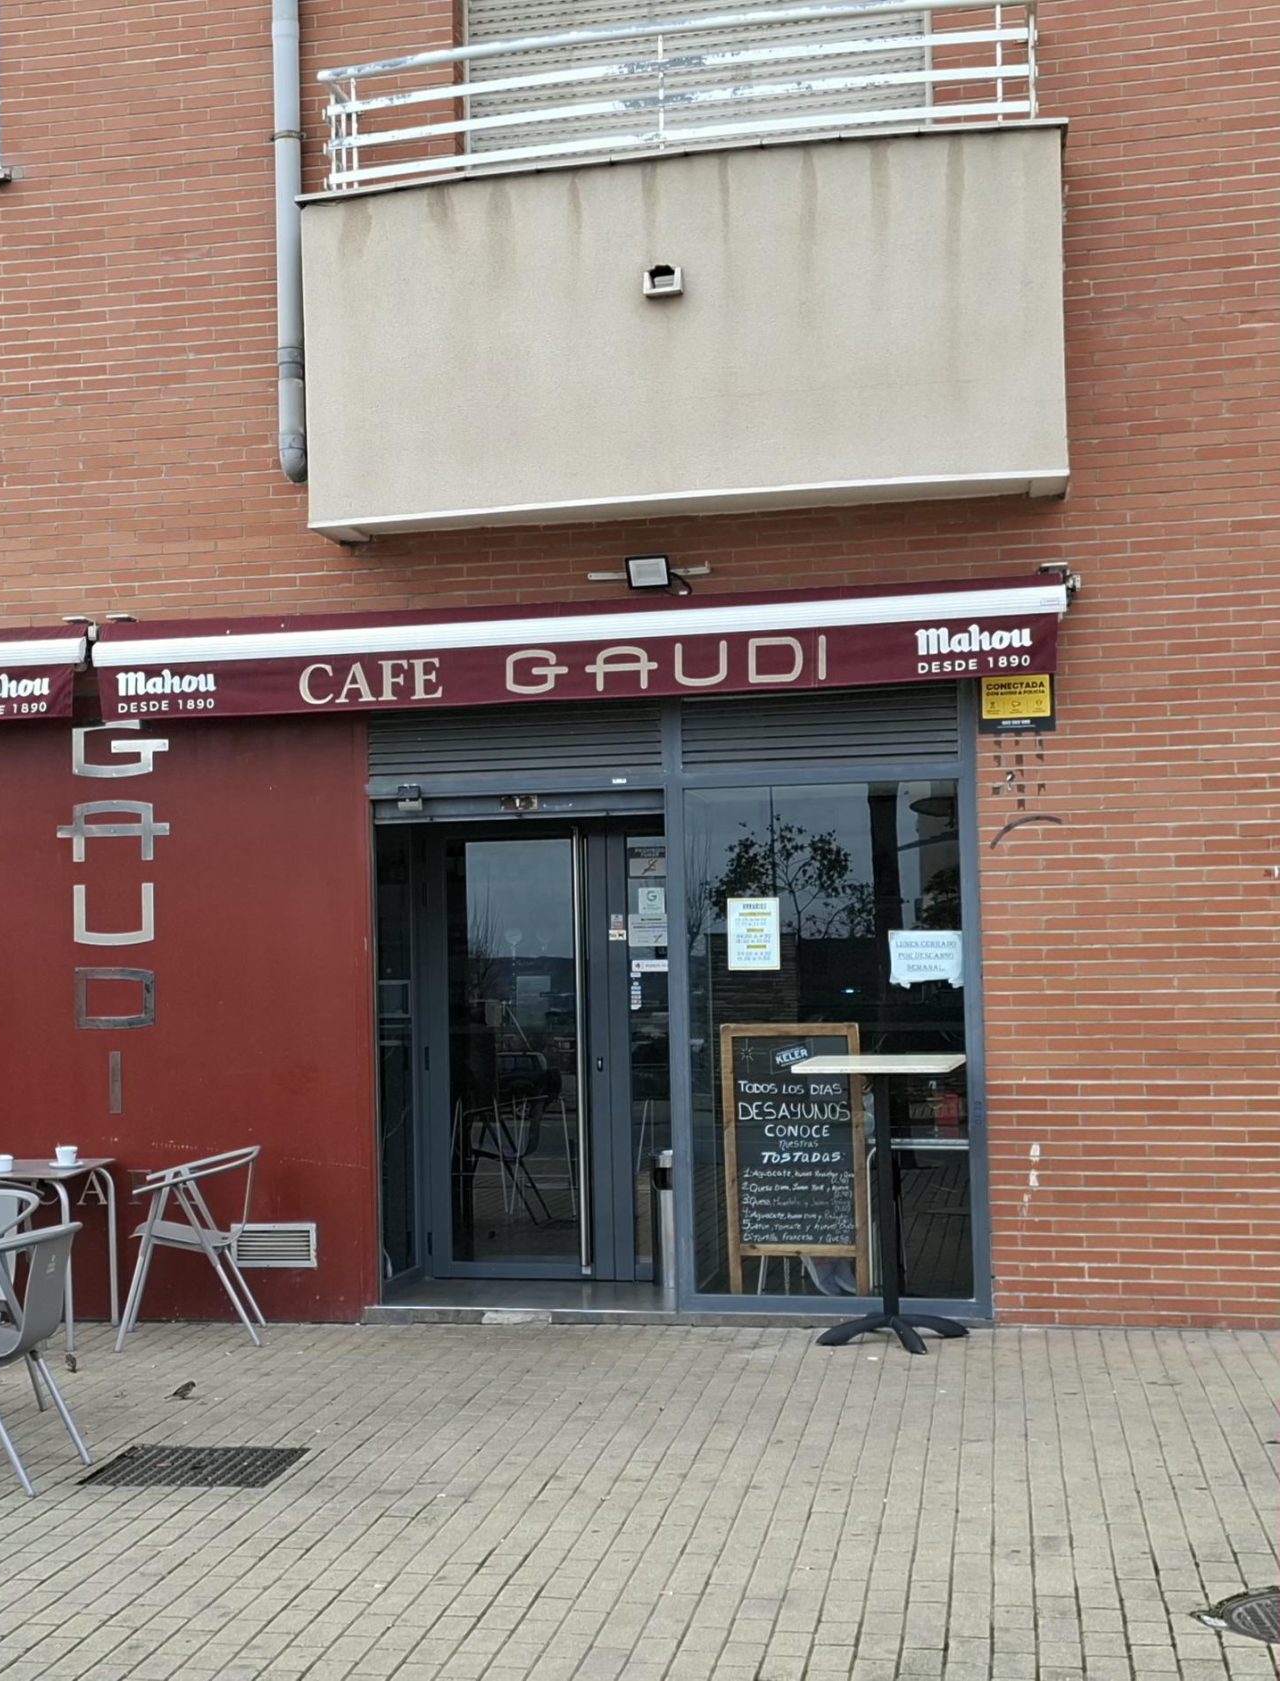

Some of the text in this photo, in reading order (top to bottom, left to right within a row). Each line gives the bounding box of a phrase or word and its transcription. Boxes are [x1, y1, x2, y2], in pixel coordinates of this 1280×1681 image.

[915, 623, 1033, 656] Mahou
[298, 634, 826, 704] CAFE GAUDI
[917, 655, 1031, 674] DESDE 1890
[116, 668, 216, 696] Mahou
[986, 681, 1045, 690] CONECTADA
[12, 701, 47, 714] 1890
[117, 698, 215, 713] DESDE 1890
[57, 720, 169, 1113] GAUDI
[775, 1048, 808, 1065] KELER
[738, 1080, 842, 1095] TODOS LOS DIAS
[738, 1101, 851, 1121] DESAYUNOS
[764, 1124, 830, 1138] CONOCE
